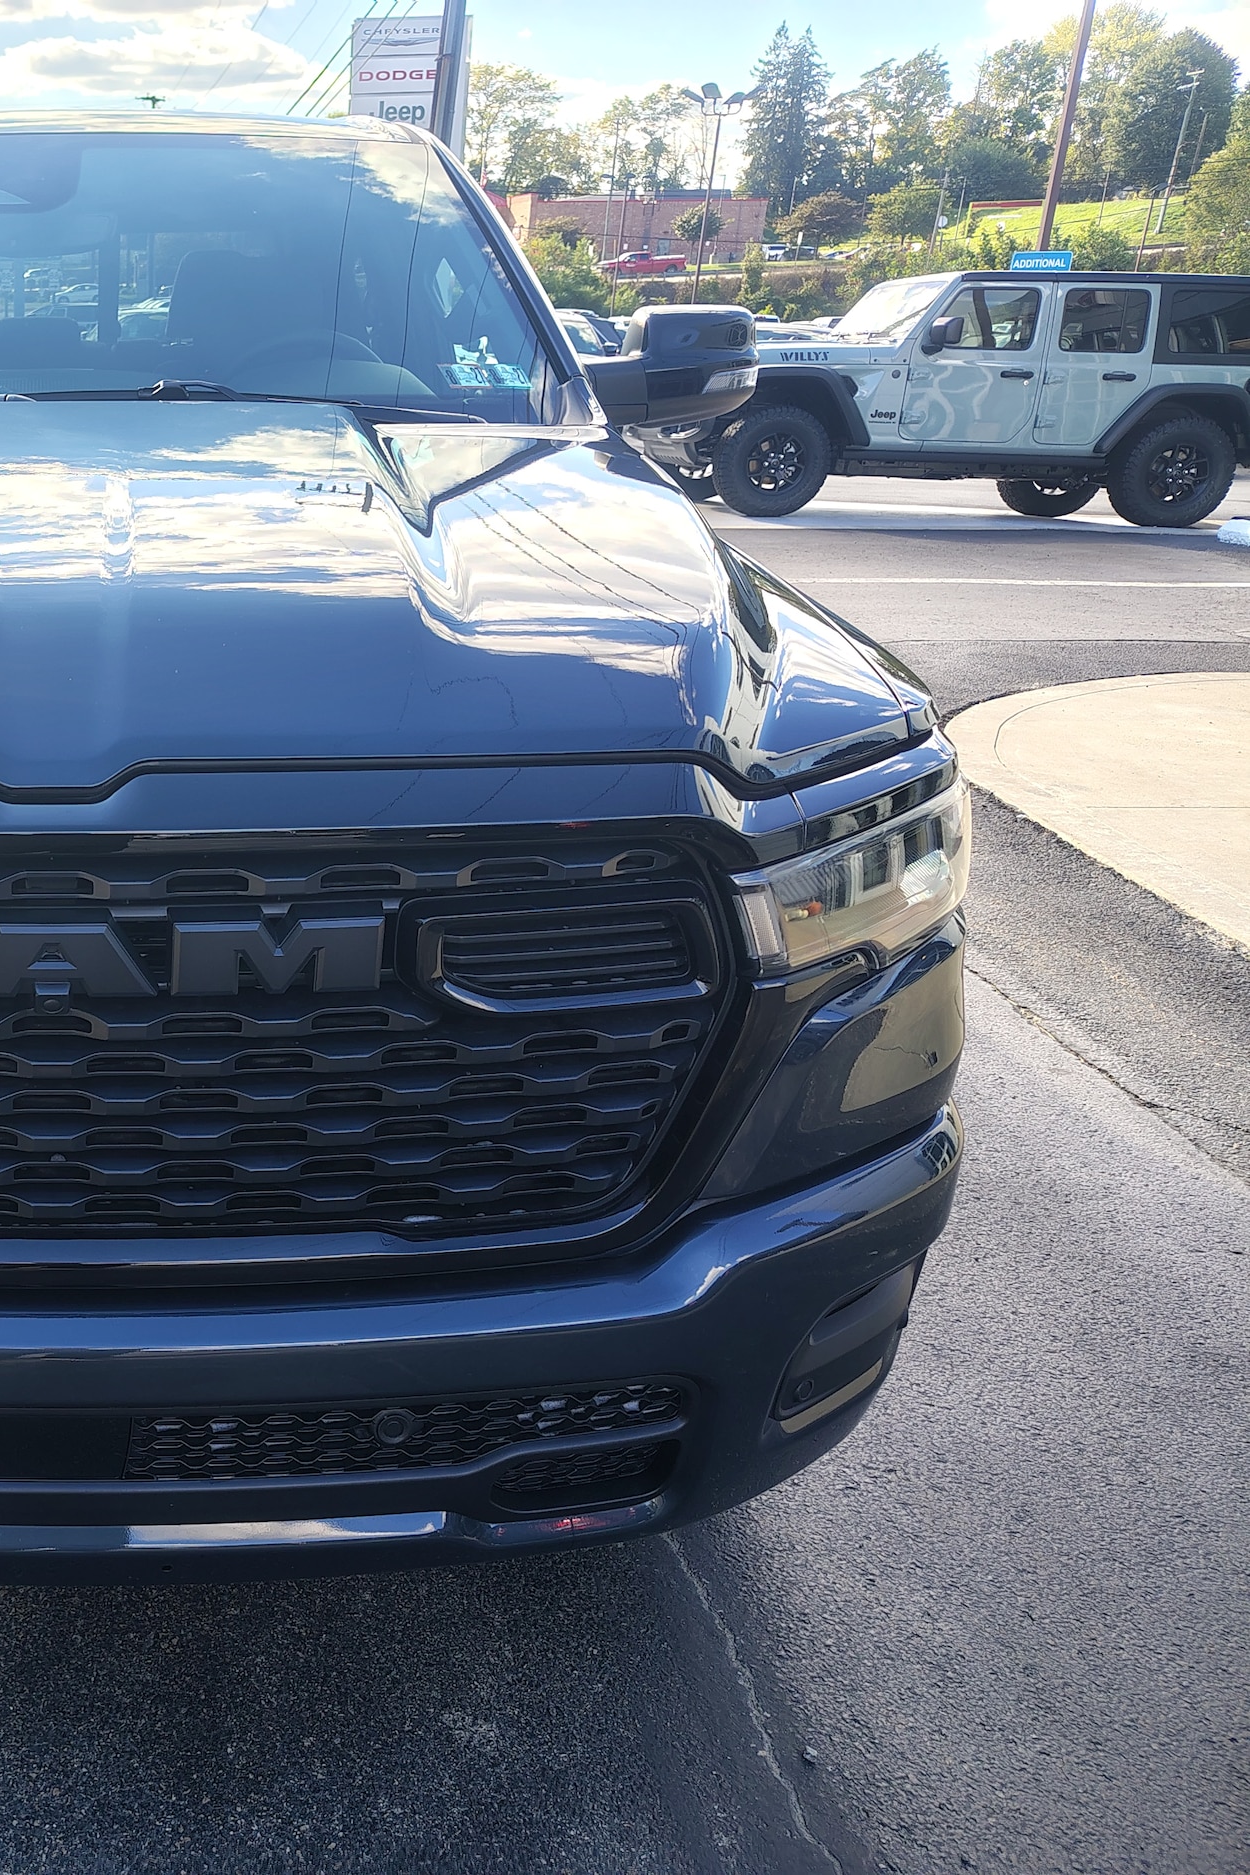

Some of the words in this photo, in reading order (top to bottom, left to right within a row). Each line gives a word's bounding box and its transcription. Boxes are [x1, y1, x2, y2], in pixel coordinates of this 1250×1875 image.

[363, 27, 440, 36] CHRYSLER
[358, 69, 437, 82] DODGE
[369, 100, 426, 125] Jeep
[1012, 258, 1067, 269] ADDITIONAL
[779, 351, 830, 362] WILLYS
[870, 409, 897, 421] Jeep
